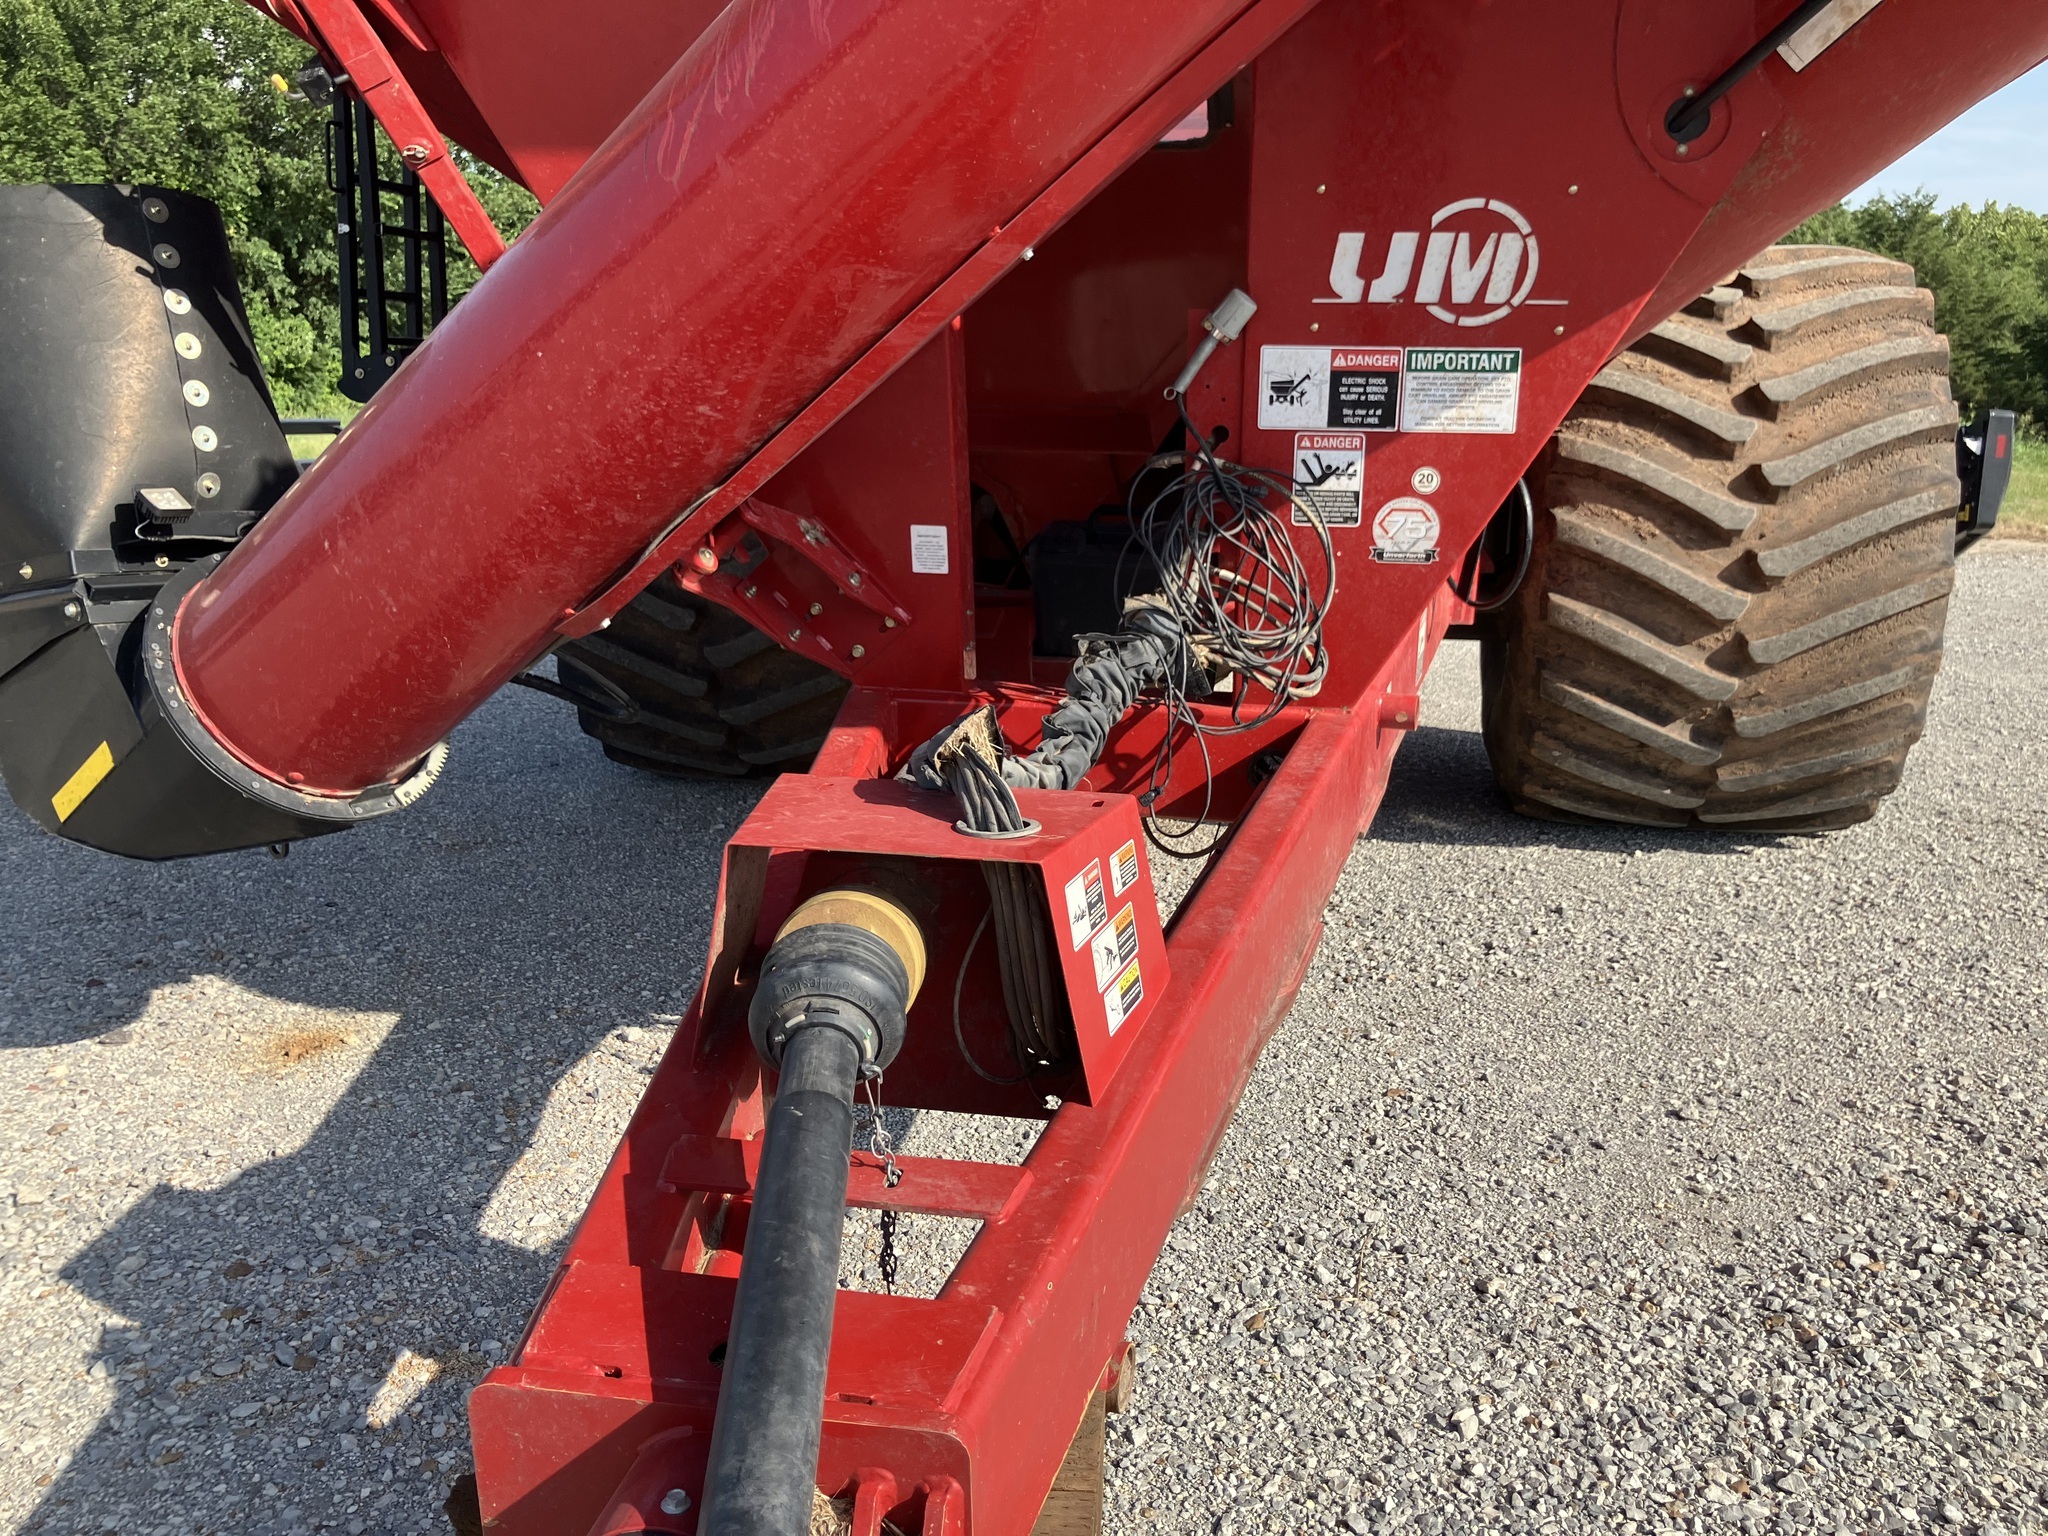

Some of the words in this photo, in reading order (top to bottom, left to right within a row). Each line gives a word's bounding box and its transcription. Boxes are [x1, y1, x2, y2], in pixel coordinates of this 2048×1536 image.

[1347, 354, 1399, 367] DANGER
[1411, 352, 1515, 371] IMPORTANT
[1341, 377, 1366, 385] ELECTRIC
[1342, 408, 1353, 416] Stay
[1313, 437, 1360, 449] DANGER
[1418, 473, 1434, 484] 20
[1385, 515, 1427, 539] 75
[781, 977, 822, 998] tested
[822, 979, 859, 997] 5674
